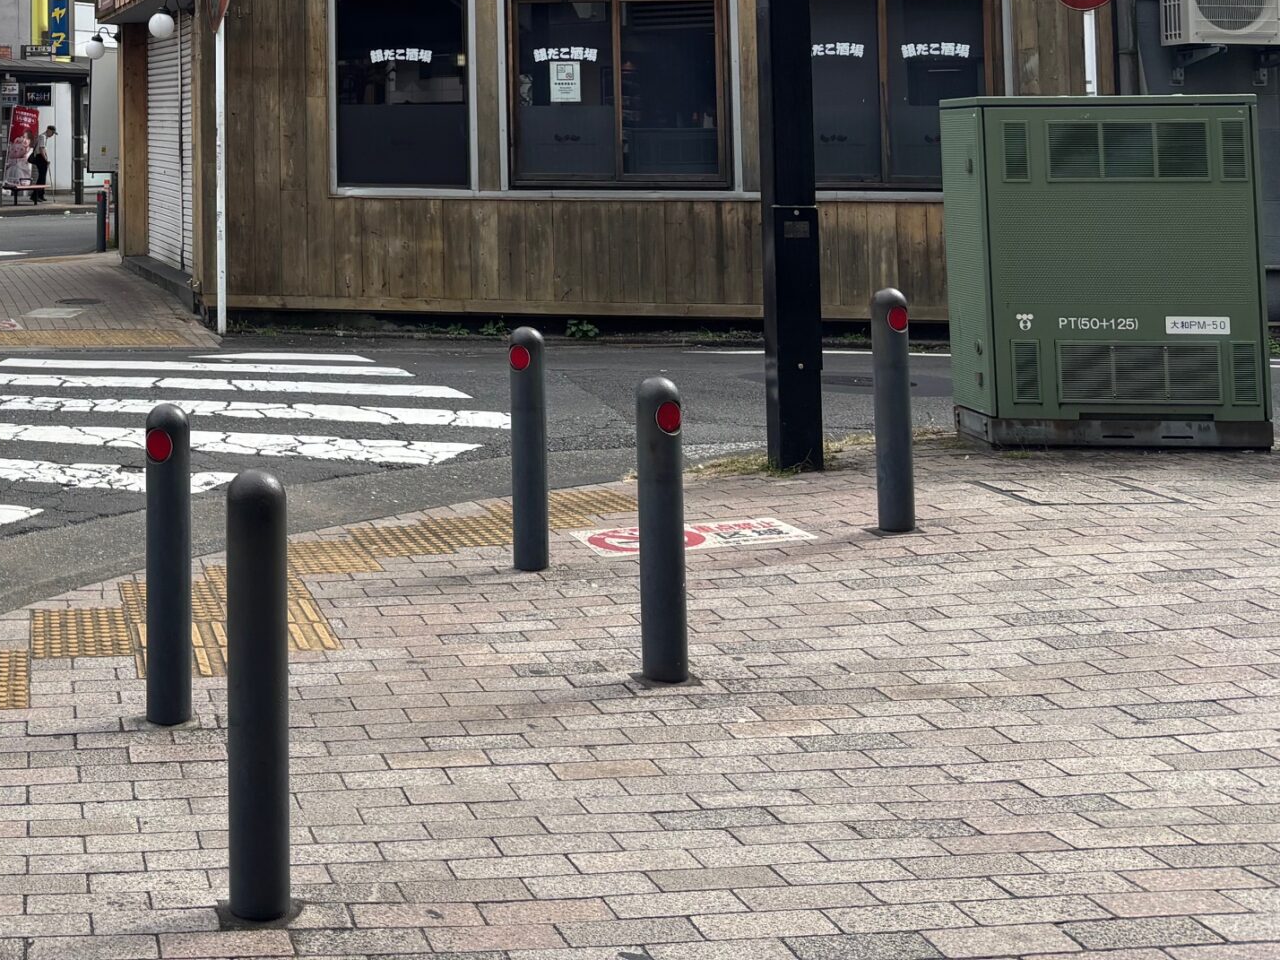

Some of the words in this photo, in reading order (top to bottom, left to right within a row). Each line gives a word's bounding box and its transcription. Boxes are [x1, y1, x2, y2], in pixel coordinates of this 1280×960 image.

[370, 48, 432, 64] 銀だこ酒場
[533, 46, 598, 62] 銀だこ酒場
[811, 42, 865, 58] だこ酒場
[901, 42, 971, 59] 銀だこ酒場
[1058, 317, 1139, 331] PT(50+125)
[1170, 319, 1226, 331] 大和PM-50
